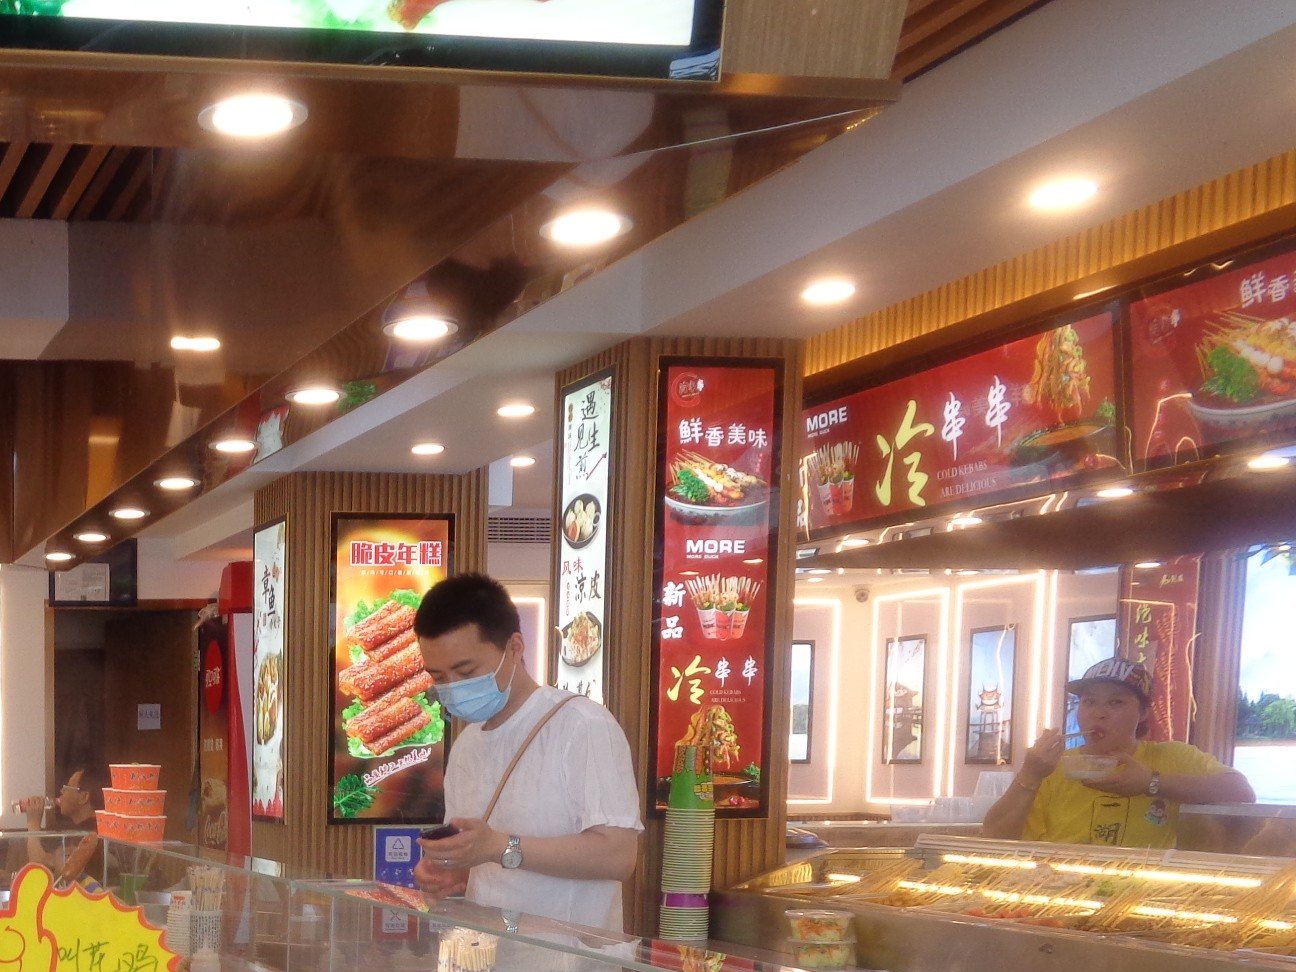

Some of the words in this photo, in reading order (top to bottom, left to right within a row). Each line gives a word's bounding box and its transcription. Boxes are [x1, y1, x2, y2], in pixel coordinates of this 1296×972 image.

[1240, 271, 1296, 308] 鲜香
[679, 417, 767, 448] 鲜香美味
[806, 406, 848, 433] MORE
[350, 541, 442, 566] 脆皮年糕
[686, 539, 745, 554] MORE
[661, 581, 686, 640] 新品
[667, 655, 758, 705] 冷串串
